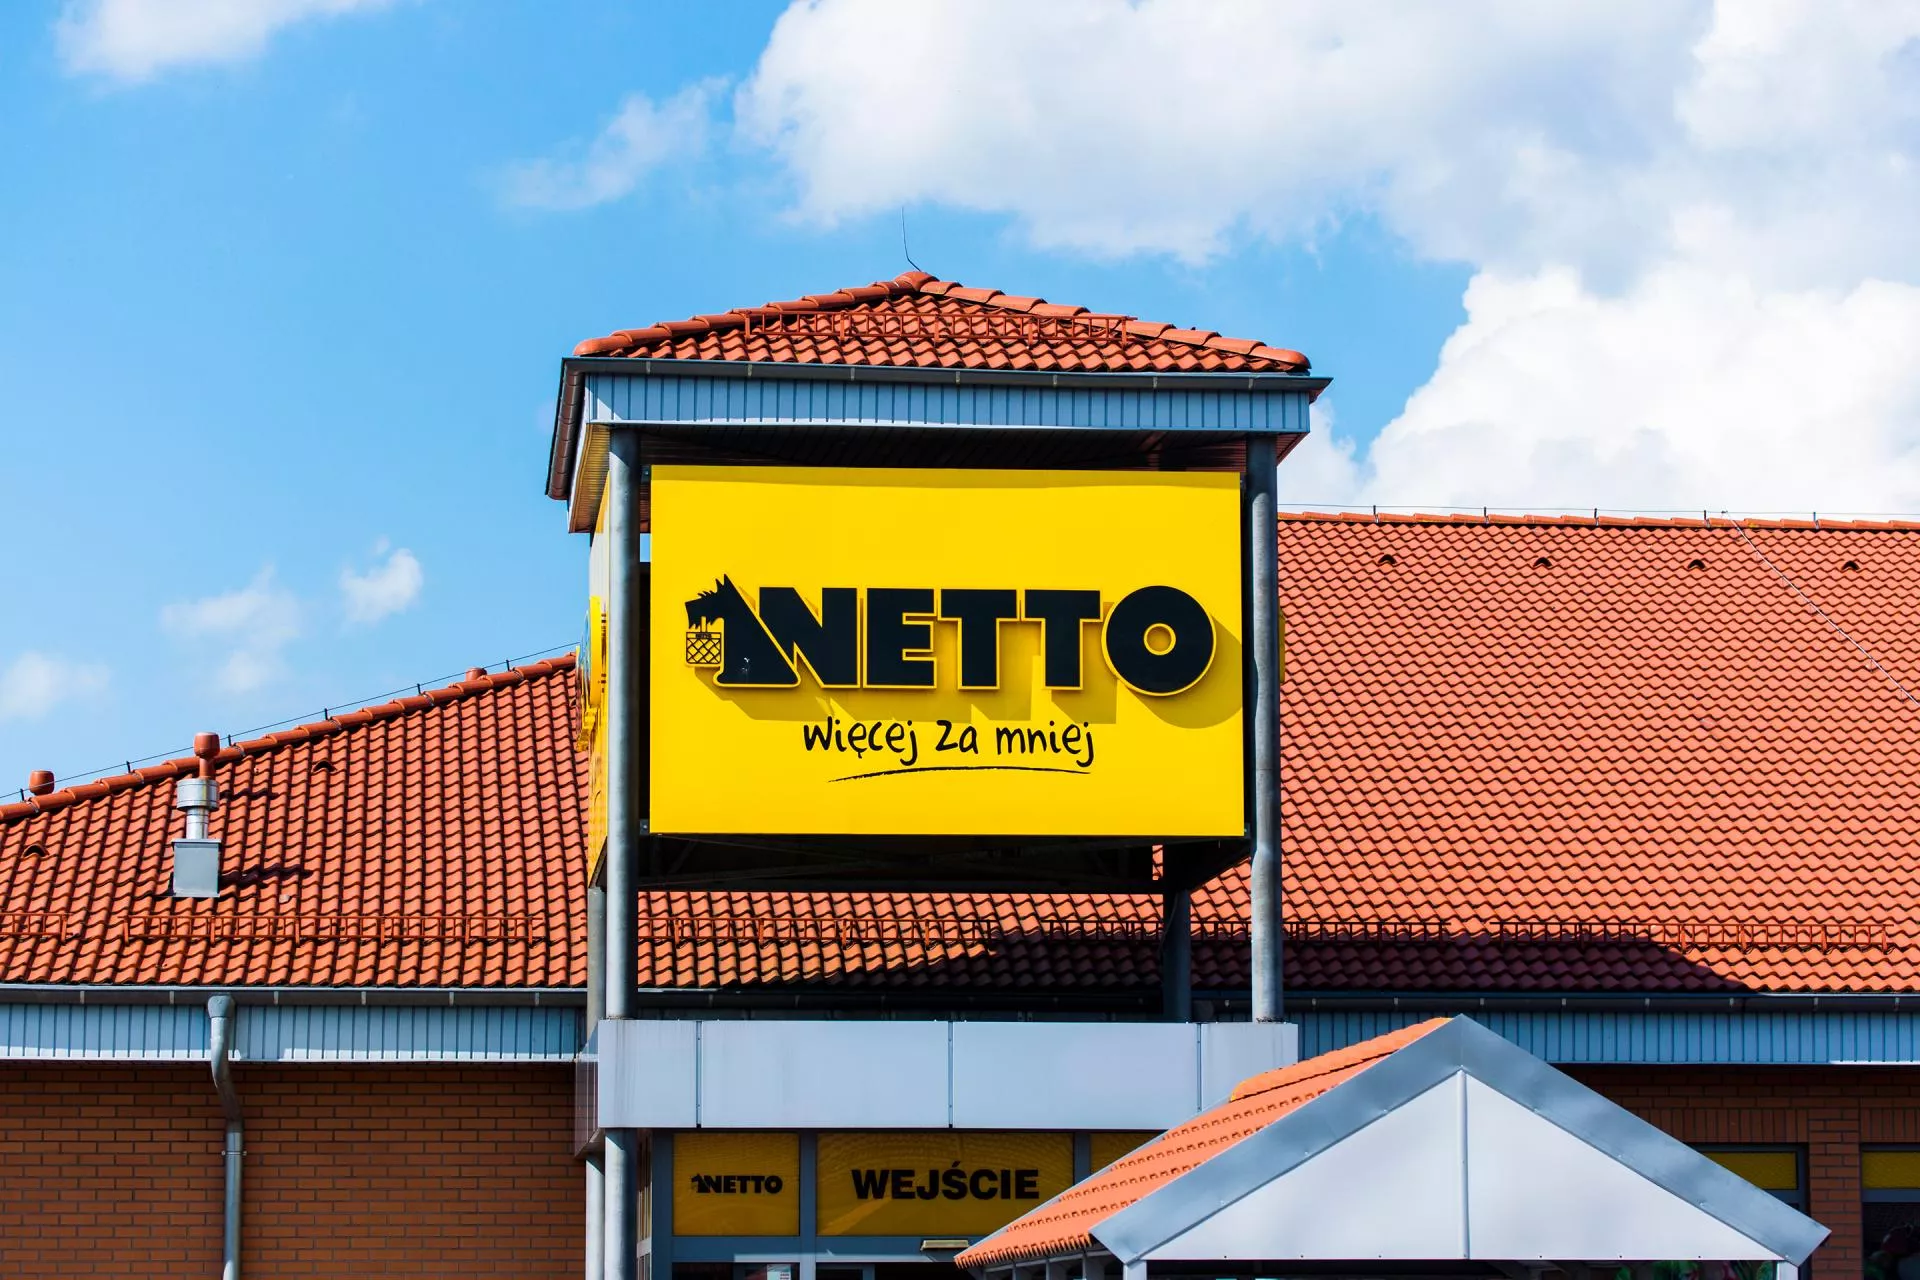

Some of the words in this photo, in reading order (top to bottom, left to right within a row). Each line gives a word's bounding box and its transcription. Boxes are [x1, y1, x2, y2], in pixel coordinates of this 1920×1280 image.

[758, 585, 1214, 694] NETTO
[996, 720, 1094, 768] mniej
[707, 1175, 783, 1194] NETTO
[851, 1161, 1040, 1201] WEJŚCIE
